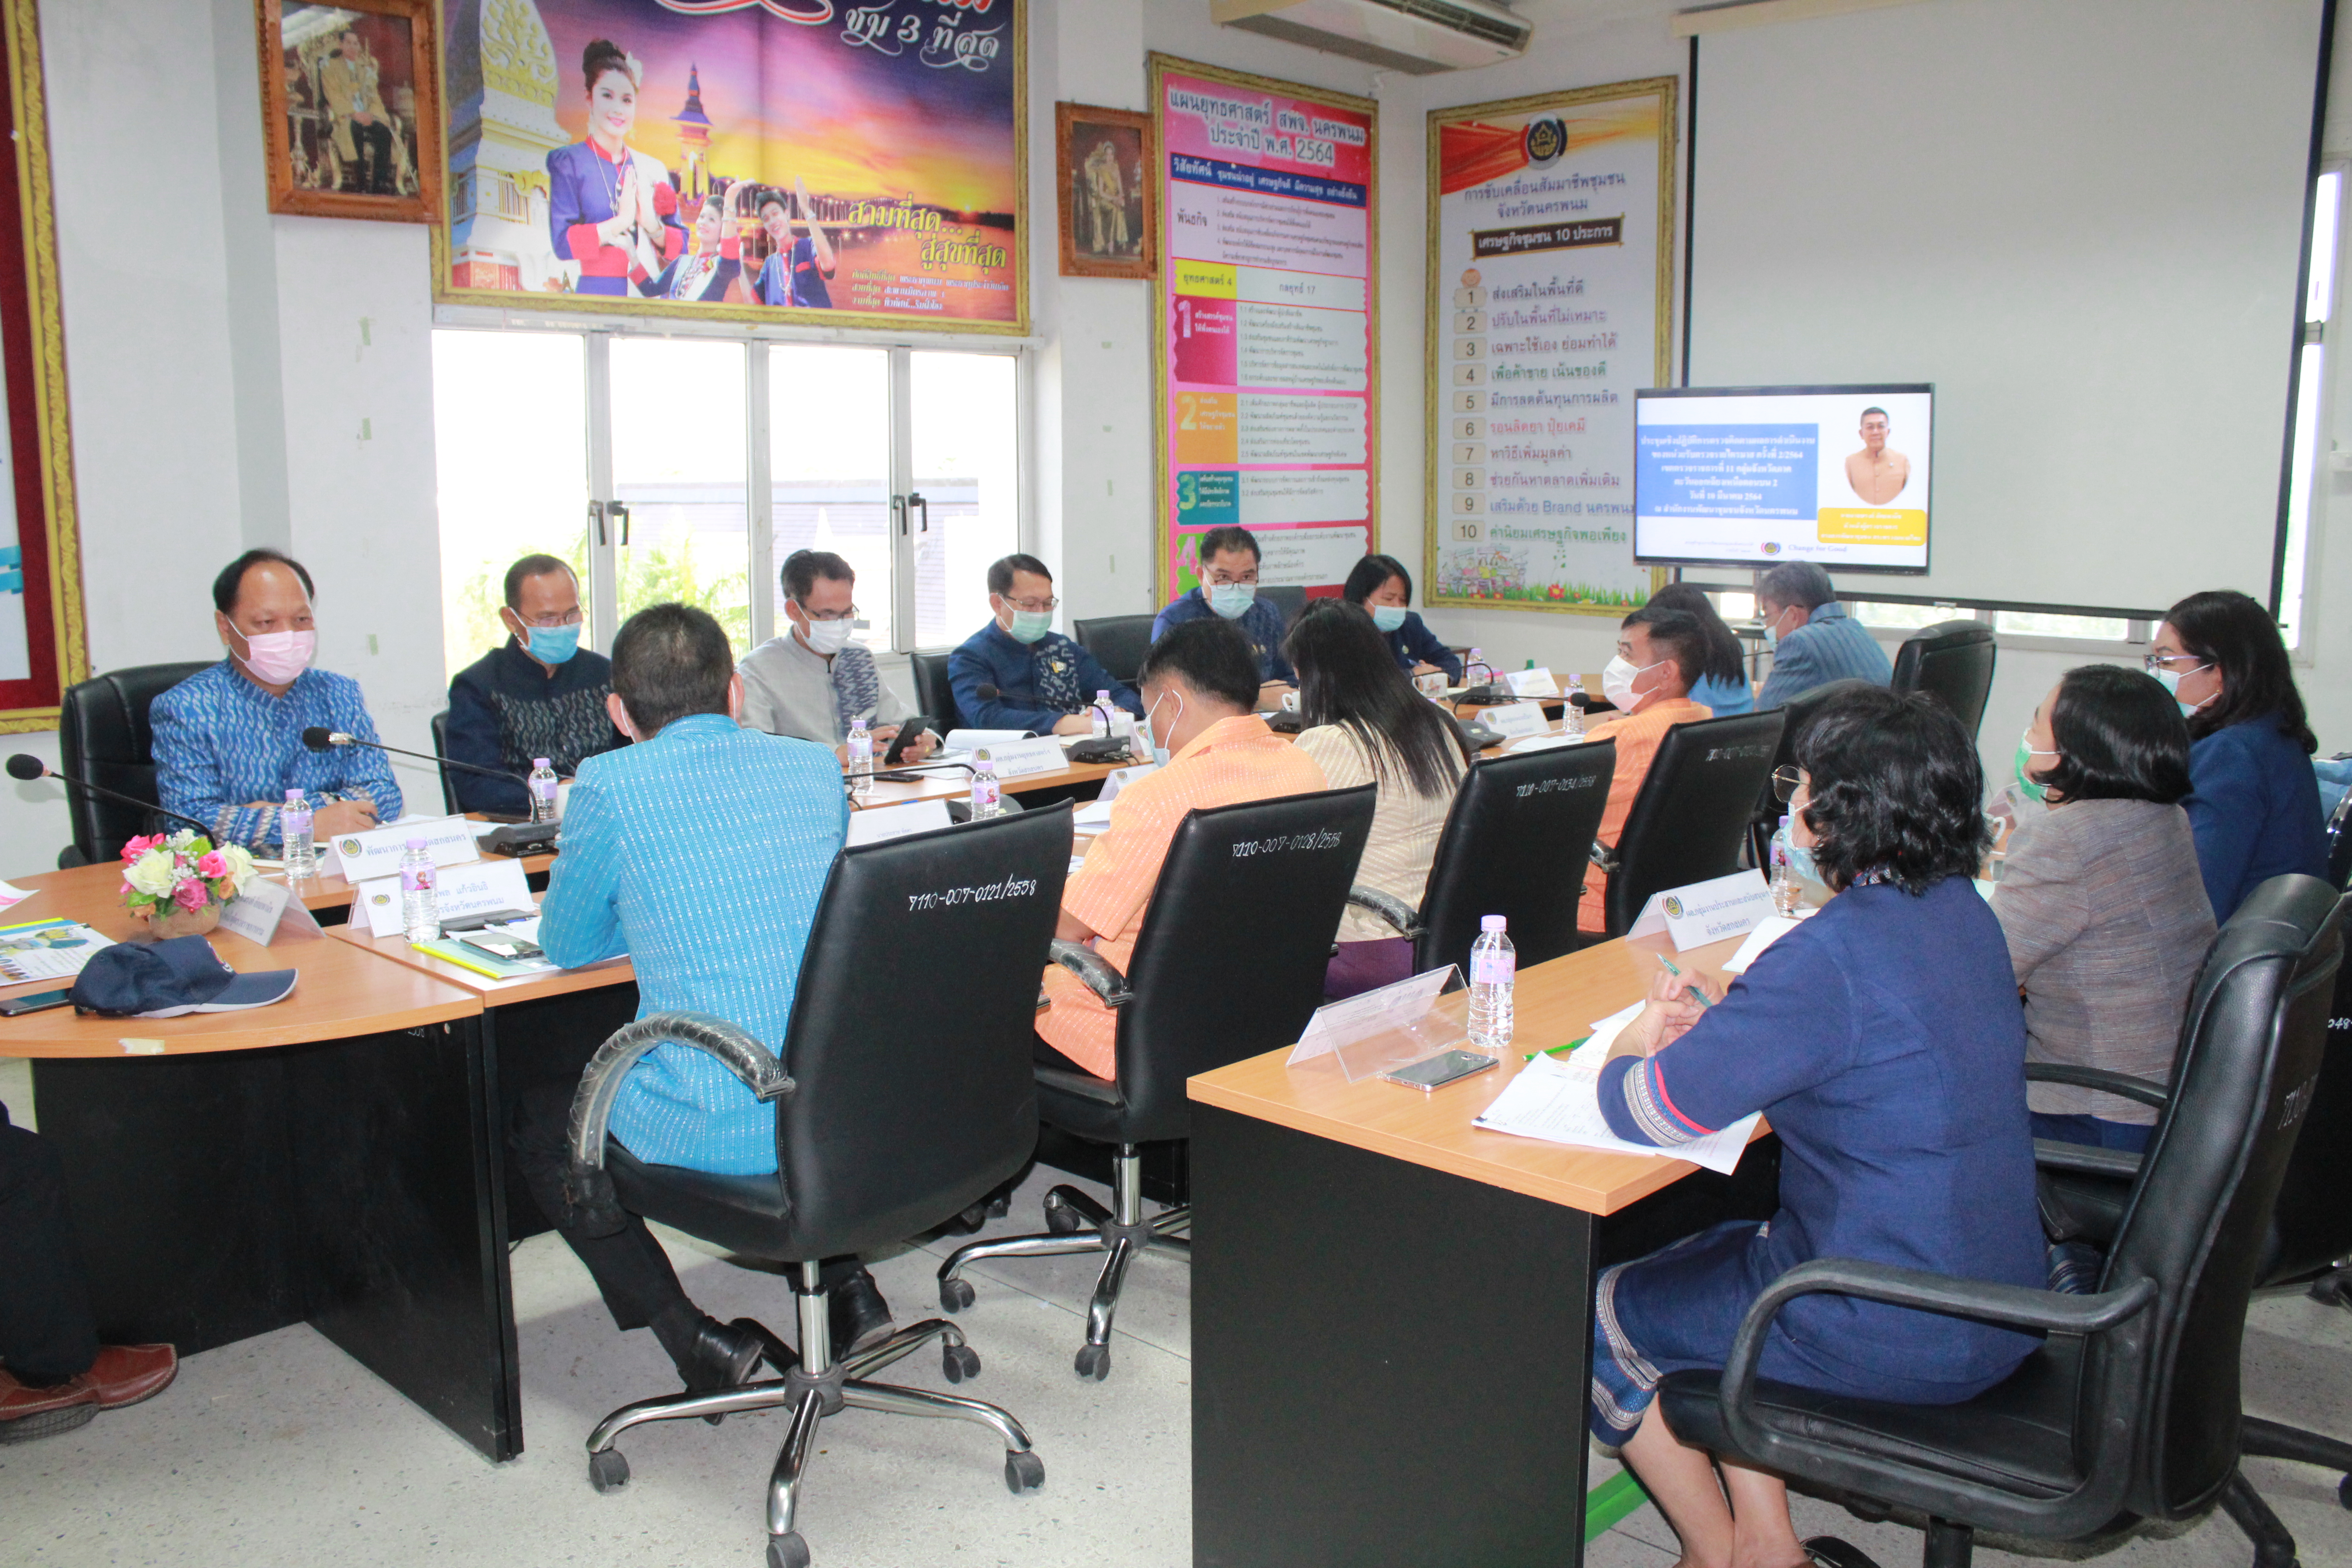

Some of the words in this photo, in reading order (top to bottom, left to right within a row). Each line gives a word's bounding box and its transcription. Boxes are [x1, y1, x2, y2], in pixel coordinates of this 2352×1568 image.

[897, 15, 921, 43] 3
[920, 12, 1006, 72] ที่สุด
[1169, 91, 1269, 125] แผนยุทธศาสตร์
[1279, 112, 1309, 132] สพจ.
[1313, 118, 1365, 143] นครพนม
[1210, 123, 1260, 150] ประจำปี
[1265, 135, 1293, 156] พ.ศ.
[1297, 138, 1334, 164] 2564
[1173, 157, 1212, 176] วิสัยทัศน์
[1465, 172, 1625, 202] การขับเคลื่อนสัมมาชีพชุมชน
[848, 192, 963, 240] สามที่สุด...
[1177, 209, 1207, 226] พันธกิจ
[1497, 198, 1588, 219] จังหวัดนครพนม
[1478, 230, 1552, 252] เศรษฐกิจชุมชน
[1556, 228, 1570, 241] 10
[1573, 224, 1613, 240] ประการ
[921, 230, 1006, 275] สู่สุขที่สุด
[1184, 274, 1224, 285] ยุทธศาสตร์
[1279, 282, 1303, 295] กลยุทธ์
[1307, 286, 1315, 294] 17
[1468, 291, 1474, 304] 1
[1493, 275, 1584, 301] ส่งเสริมในพื้นที่ดี
[1178, 300, 1191, 338] 1
[1466, 317, 1475, 330] 2
[1492, 305, 1607, 327] ปรับในพื้นที่ไม่เหมาะ
[1466, 343, 1475, 356] 3
[1491, 337, 1557, 353] เฉพาะใช้เอง
[1562, 332, 1617, 351] ย่อมทำได้
[1466, 369, 1475, 382] 4
[1491, 362, 1548, 381] เพื่อค้าขาย
[1552, 361, 1607, 378] เน้นของดี
[1466, 396, 1475, 409] 5
[1491, 391, 1618, 409] มีการลดต้นทุนการผลิต
[1180, 396, 1197, 430] 2
[1465, 422, 1474, 436] 6
[1548, 416, 1585, 438] ปุ๋ยเคมี
[1465, 448, 1474, 460] 7
[1490, 442, 1571, 465] หาวิธีเพิ่มมูลค่า
[1778, 451, 1804, 459] 2/2564
[1465, 473, 1474, 486] 8
[1490, 468, 1620, 486] ช่วยกันหาตลาดเพิ่มเติม
[1180, 474, 1196, 510] 3
[1465, 497, 1474, 511] 9
[1490, 496, 1538, 513] เสริมด้วย
[1543, 500, 1581, 513] Brand
[1461, 525, 1476, 538] 10
[1490, 525, 1627, 544] ค่านิยมเศรษฐกิจพอเพียง
[1233, 828, 1342, 857] 7110-007-0128/2558
[909, 874, 1037, 911] 7110-007-0121/2558
[1705, 917, 1750, 936] จังหวัดสกลนคร
